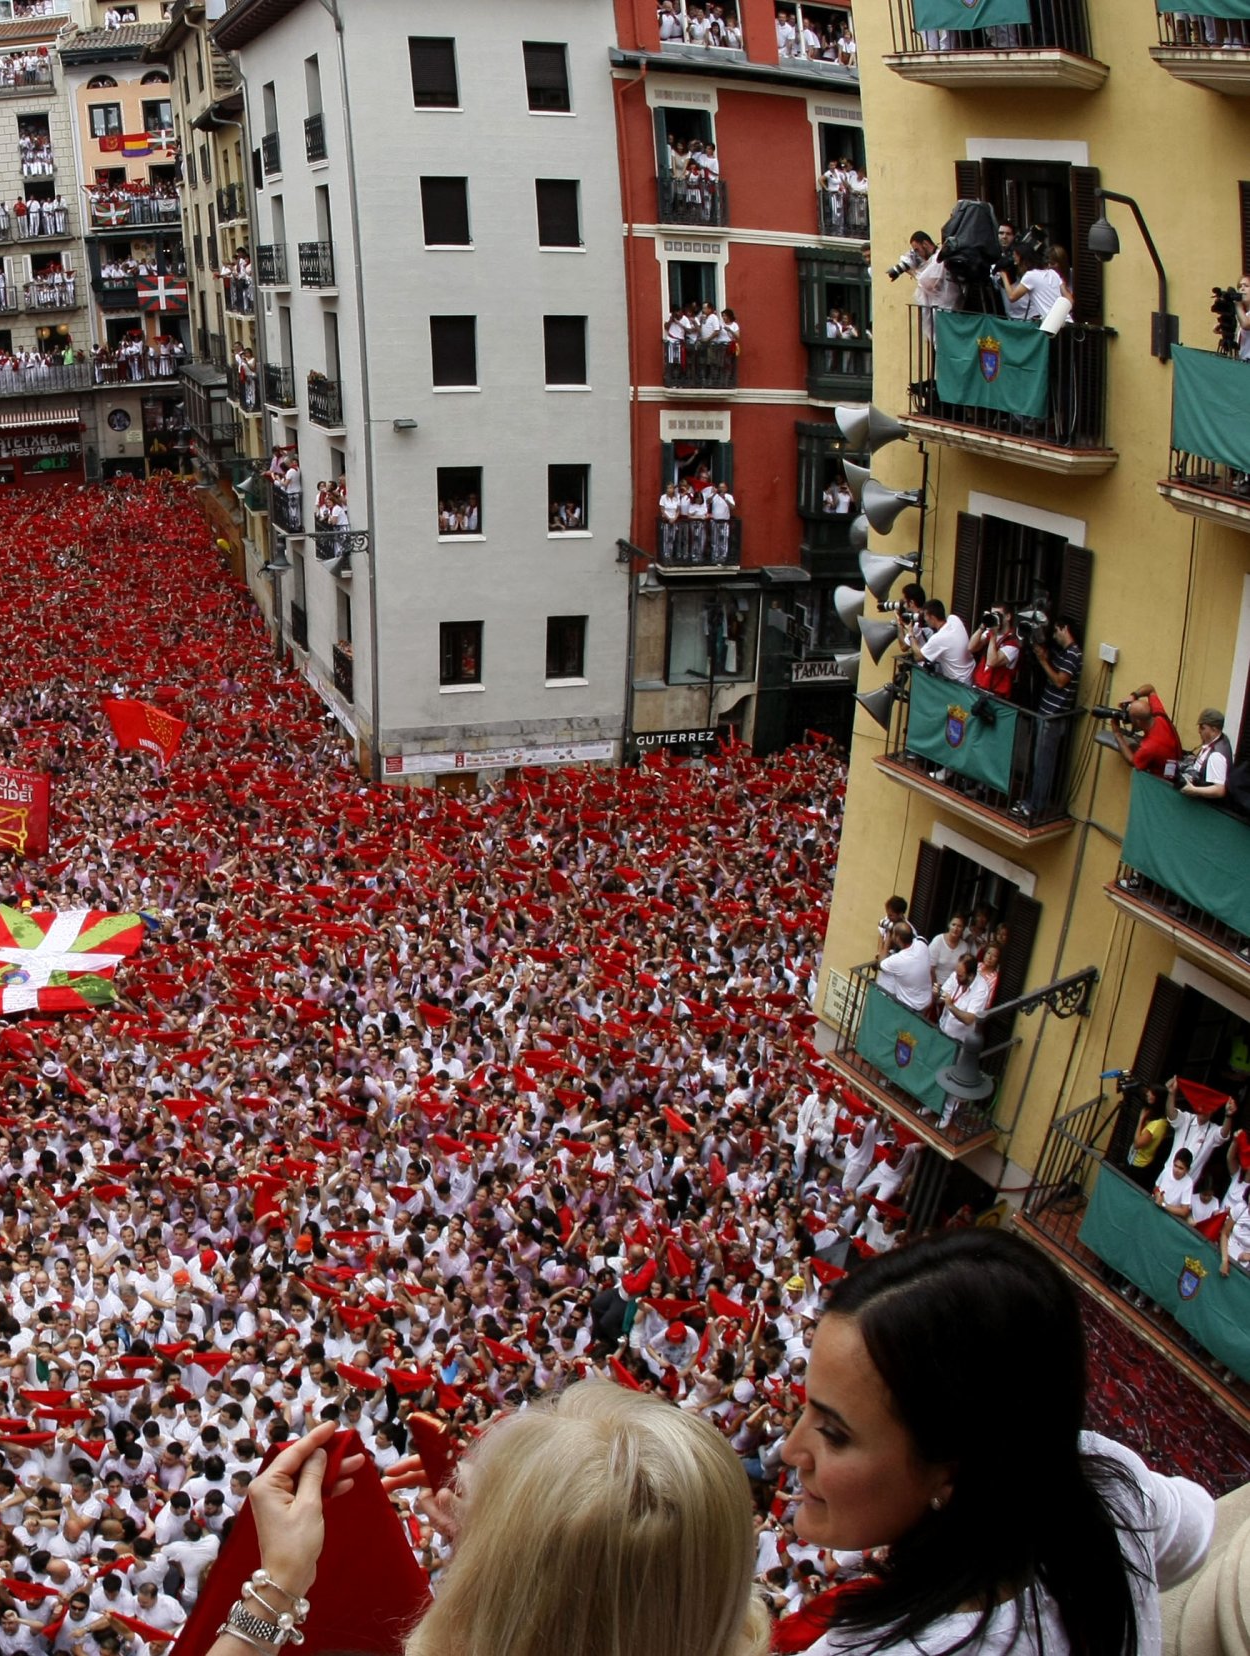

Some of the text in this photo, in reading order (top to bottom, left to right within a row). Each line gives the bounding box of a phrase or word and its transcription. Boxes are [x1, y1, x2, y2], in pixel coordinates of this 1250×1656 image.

[12, 442, 81, 457] RESTAURANTE
[636, 731, 715, 746] GUTIERREZ
[22, 783, 33, 792] ES
